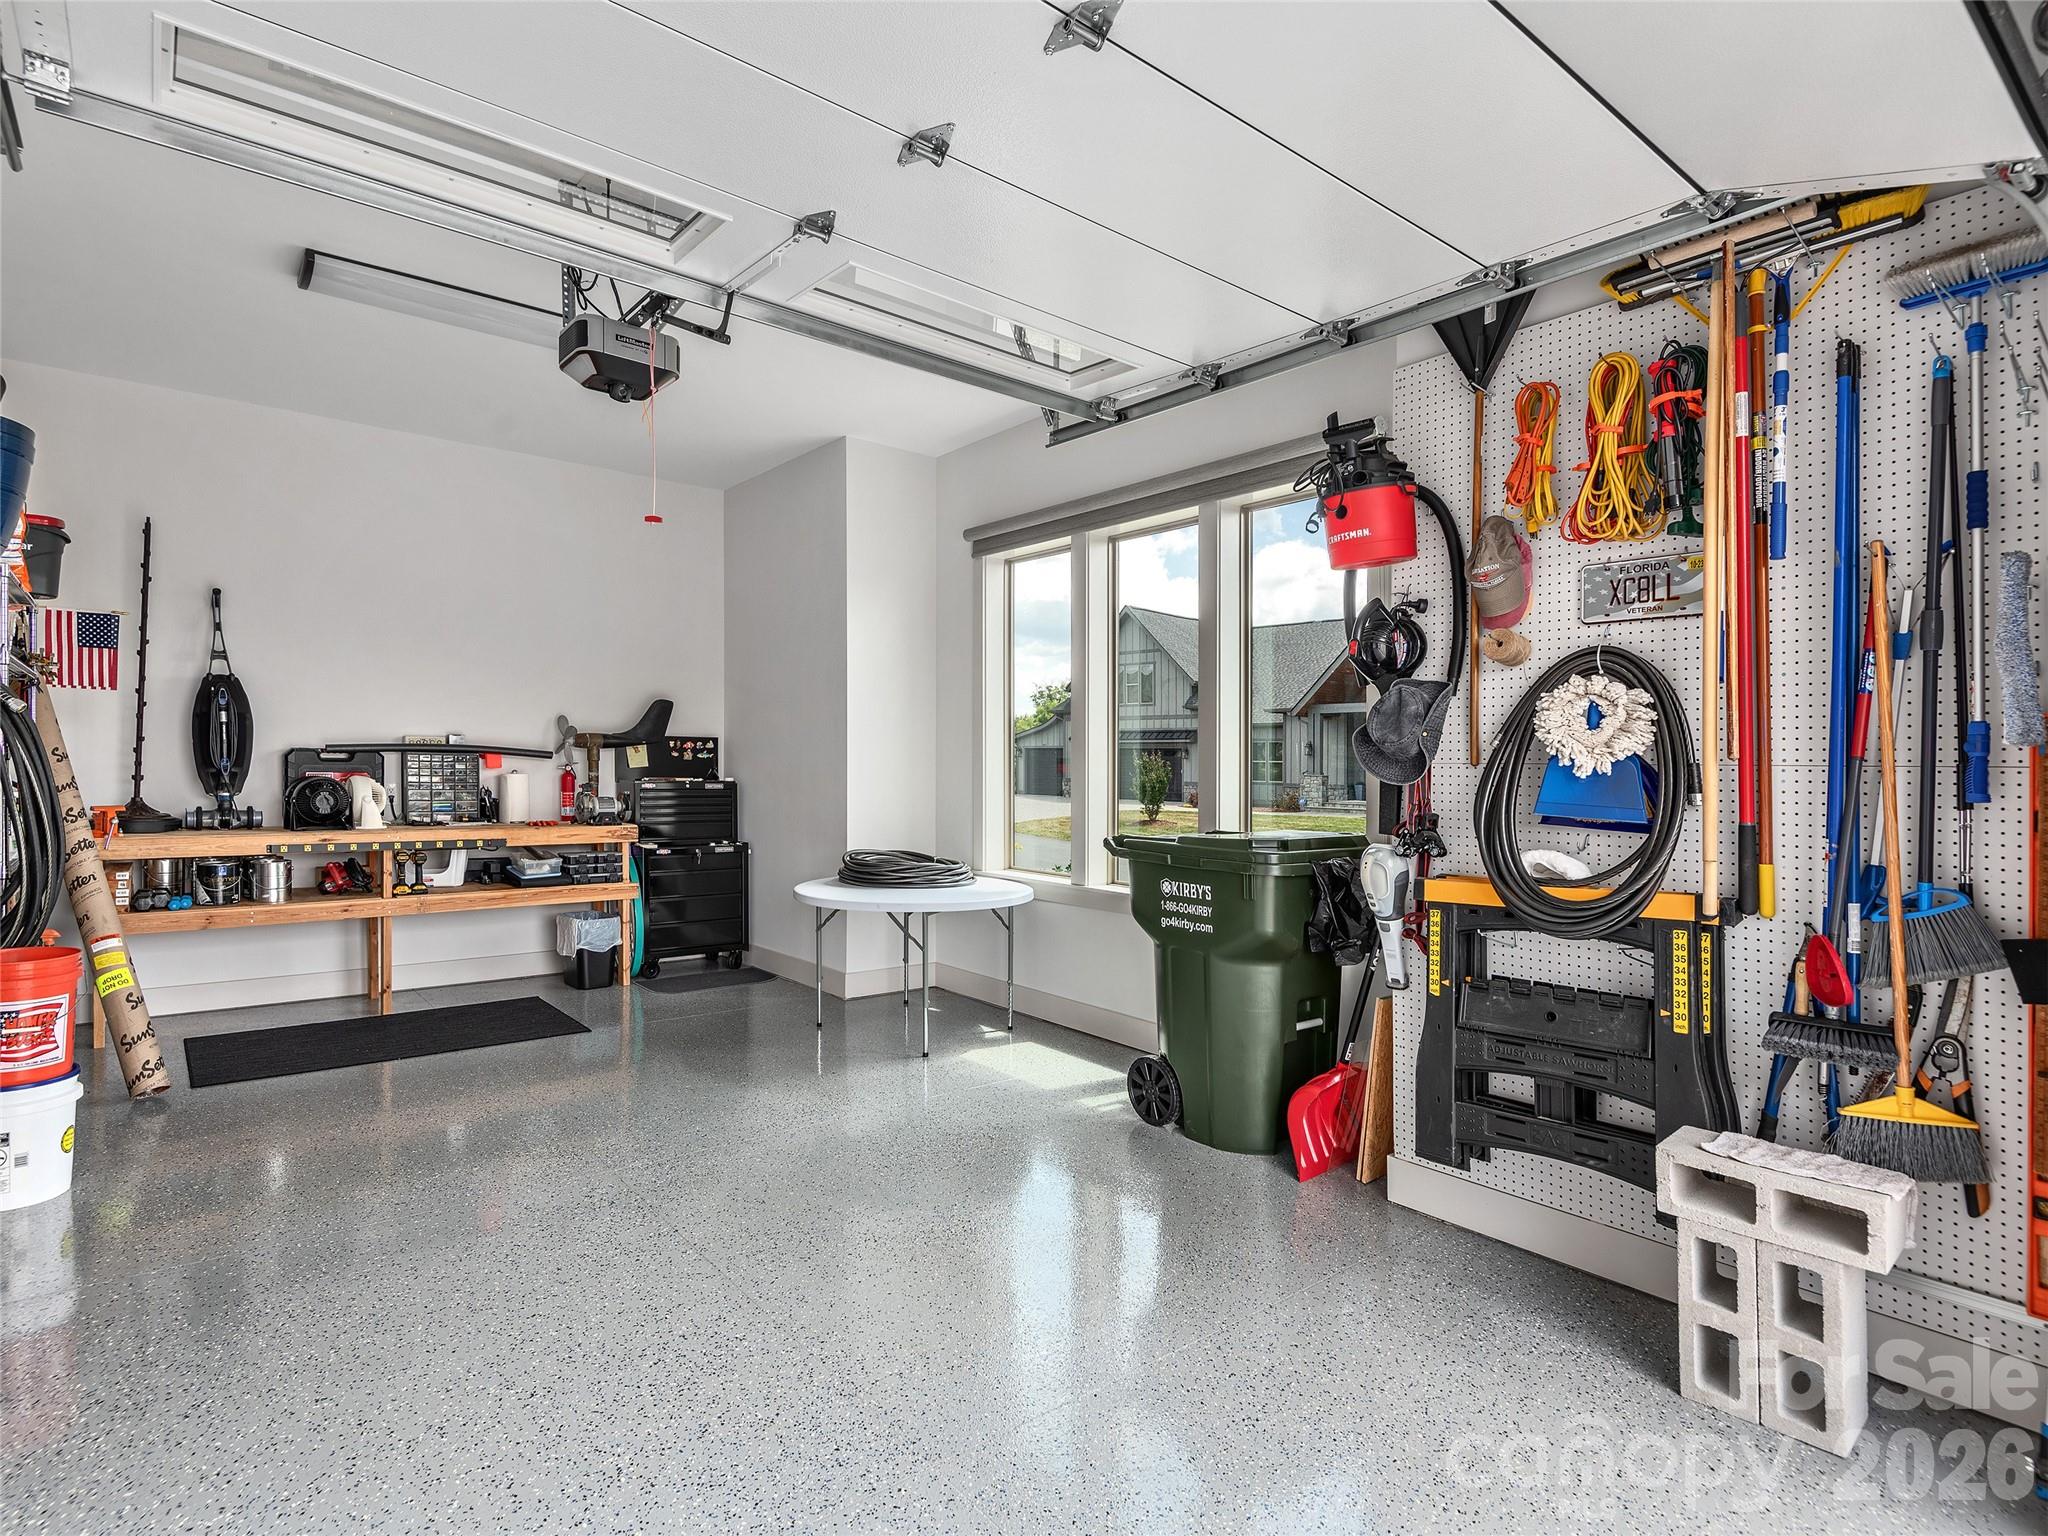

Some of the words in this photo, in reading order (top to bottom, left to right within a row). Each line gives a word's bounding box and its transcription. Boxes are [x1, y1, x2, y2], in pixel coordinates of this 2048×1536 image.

[1619, 561, 1670, 575] FLORIDA
[1626, 605, 1664, 615] VETERAN
[1172, 881, 1211, 900] KIRBY'S
[1161, 900, 1212, 917] 1-866-GO4KIRBY
[1161, 917, 1213, 933] go4kirby.com
[1674, 932, 1687, 940] 37
[1674, 944, 1687, 952] 36
[1674, 955, 1687, 964] 35
[1674, 967, 1687, 975] 34
[102, 973, 123, 986] DROP
[117, 978, 129, 986] DO
[1674, 978, 1687, 987] 33
[102, 982, 116, 993] NOT
[1674, 990, 1687, 999] 32
[1674, 1001, 1687, 1010] 31
[1674, 1013, 1687, 1021] 30
[1488, 1043, 1550, 1064] ADJUSTABLE
